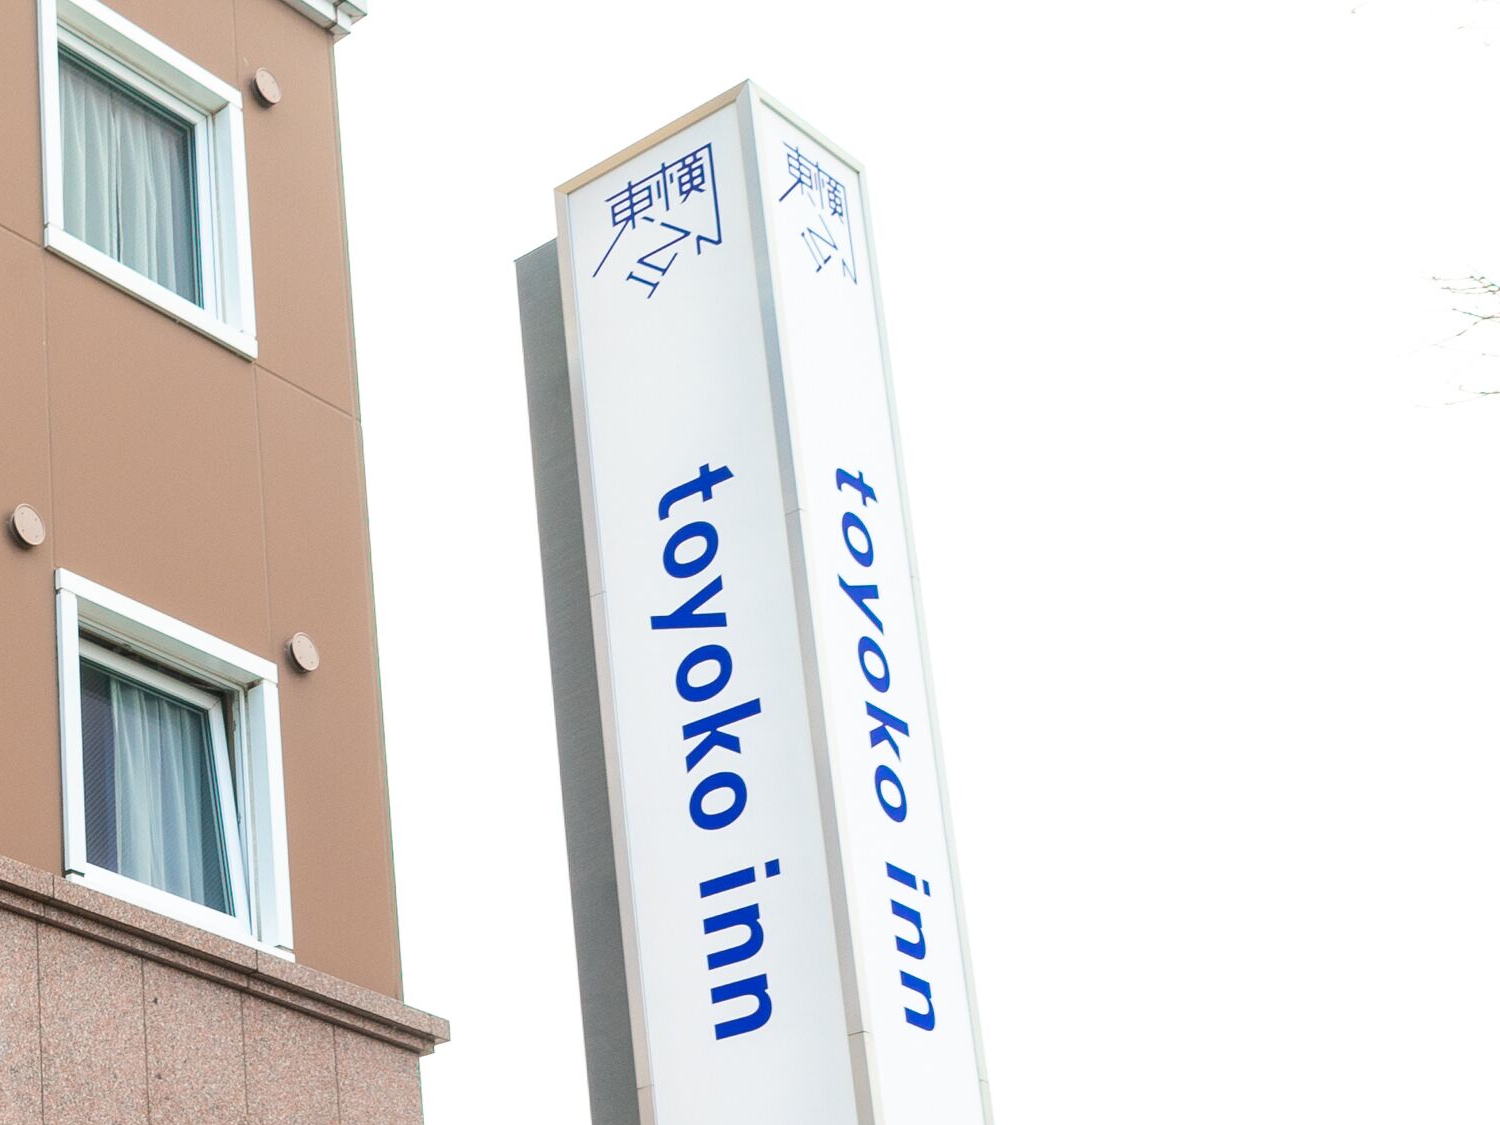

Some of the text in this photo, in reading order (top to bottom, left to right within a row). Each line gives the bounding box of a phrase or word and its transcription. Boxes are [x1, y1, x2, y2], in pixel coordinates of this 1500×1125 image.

[650, 462, 781, 1041] toyoko inn
[835, 466, 936, 1033] toyoko inn
